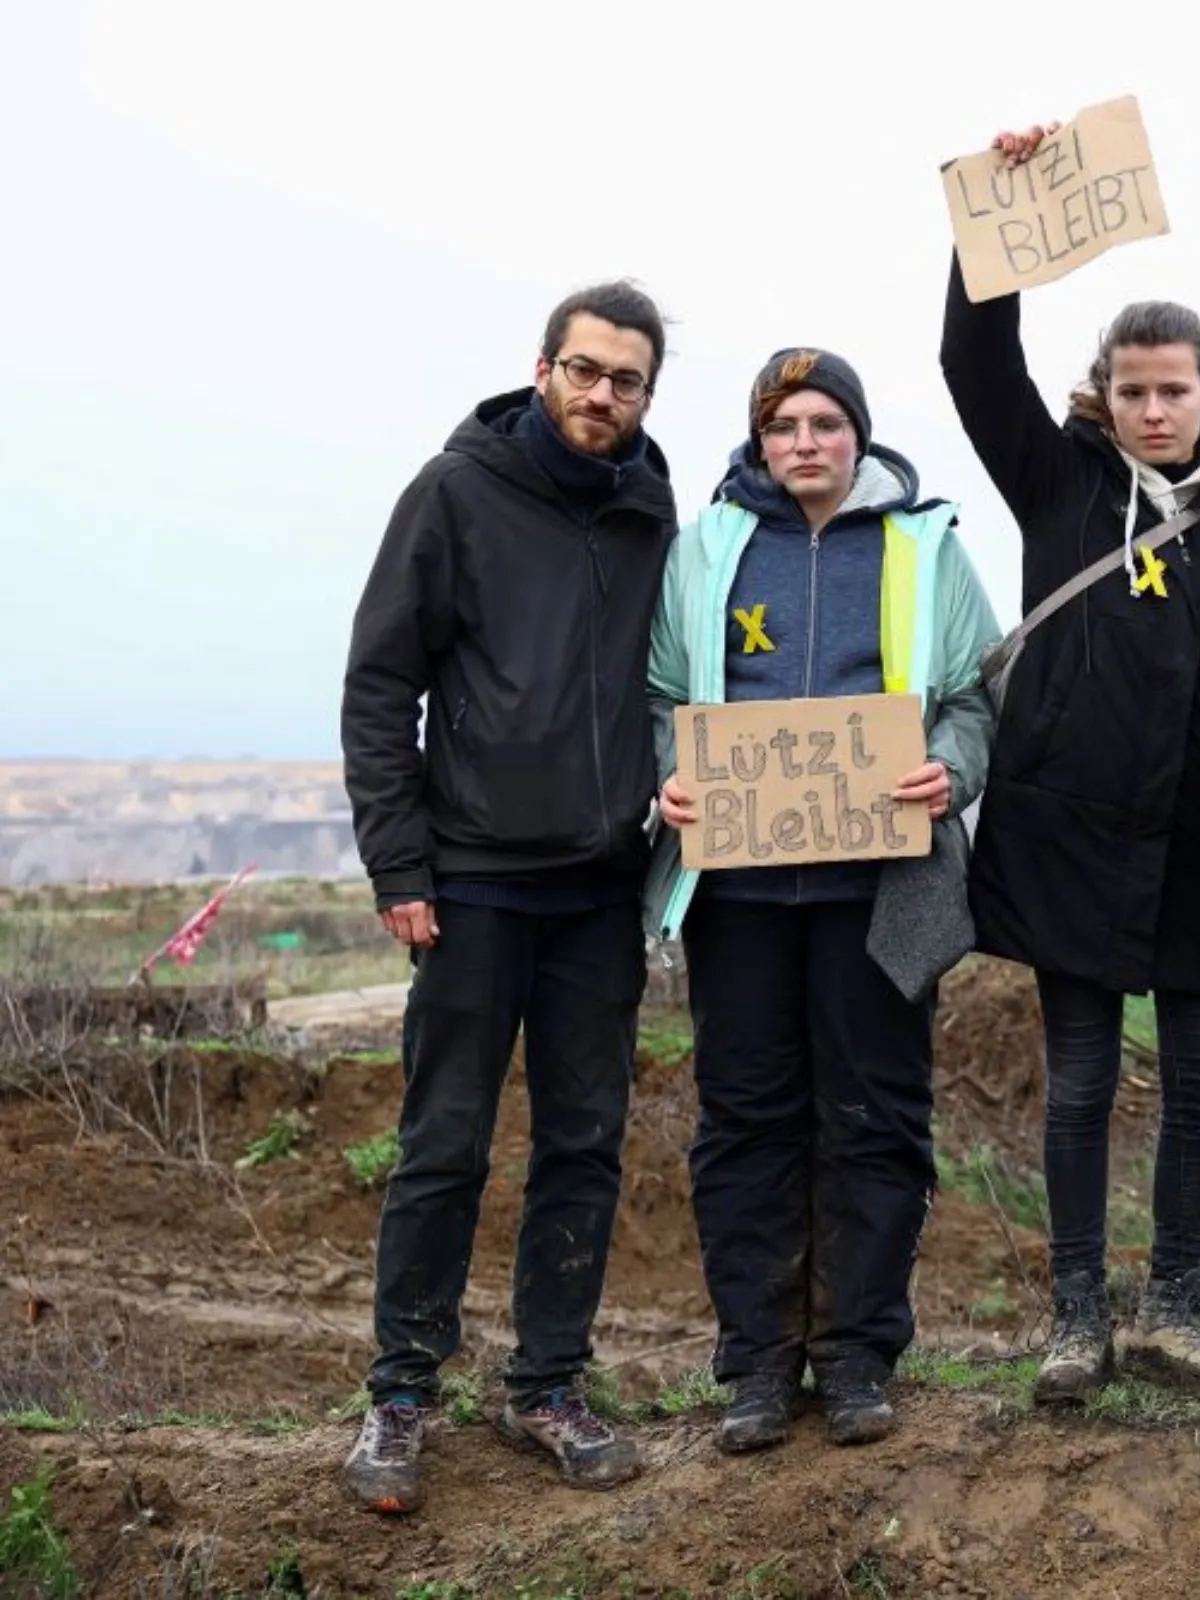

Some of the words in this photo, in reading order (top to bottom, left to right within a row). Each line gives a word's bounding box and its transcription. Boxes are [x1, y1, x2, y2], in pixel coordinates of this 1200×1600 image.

[998, 167, 1150, 275] BLEIBT
[693, 712, 876, 783] Lützi
[703, 772, 907, 860] Bleibt
